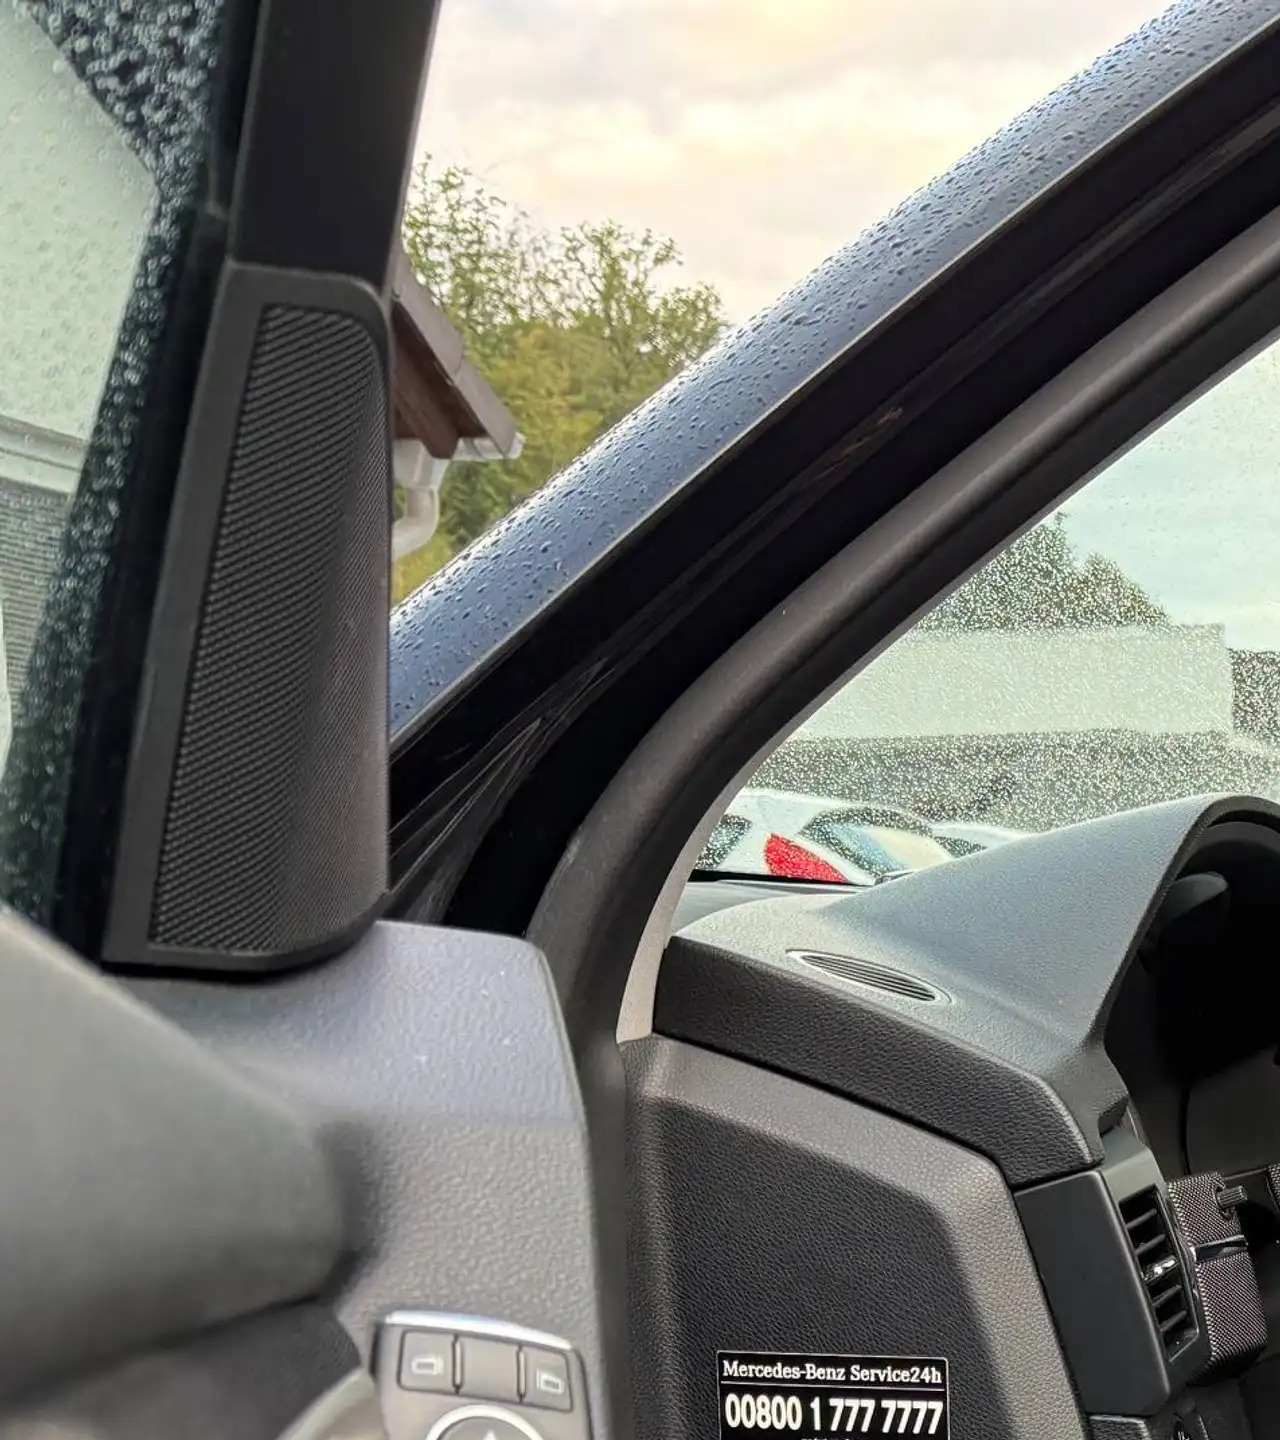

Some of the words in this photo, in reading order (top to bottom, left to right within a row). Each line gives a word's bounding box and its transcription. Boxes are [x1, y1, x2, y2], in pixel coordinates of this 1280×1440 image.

[723, 1360, 846, 1381] Mercedes-Benz
[850, 1363, 942, 1384] Service24h
[725, 1393, 802, 1431] 00800
[810, 1396, 821, 1431] 1
[829, 1397, 876, 1433] 777
[881, 1399, 944, 1435] 7777
